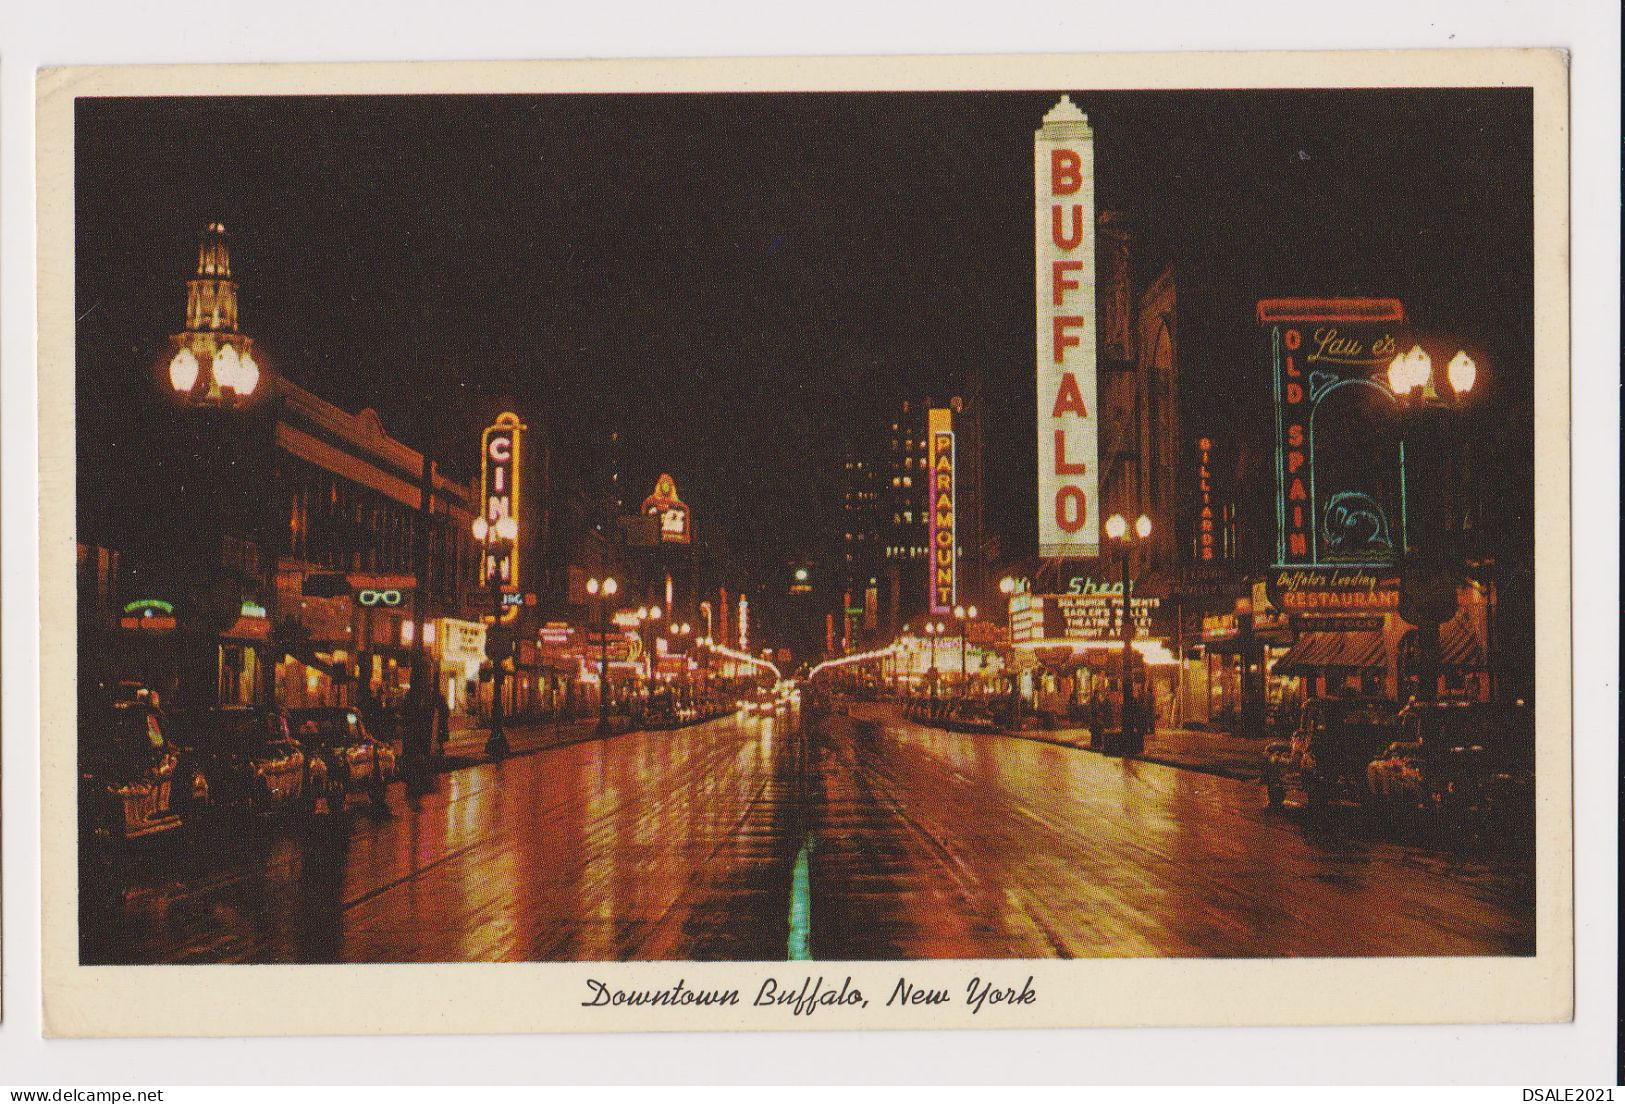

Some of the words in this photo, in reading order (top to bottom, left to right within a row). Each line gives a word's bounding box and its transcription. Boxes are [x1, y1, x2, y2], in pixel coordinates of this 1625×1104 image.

[1050, 149, 1087, 533] BUFFALO
[1285, 329, 1303, 404] OLD
[936, 436, 952, 604] PARAMOUNT
[1200, 437, 1213, 561] BILLIARDS
[1288, 424, 1307, 556] SPAIN
[1283, 591, 1399, 608] RESTAURANT
[581, 978, 740, 1006] Downtown
[752, 976, 869, 1017] Buffalo,
[886, 977, 951, 1006] New
[966, 975, 1037, 1015] York
